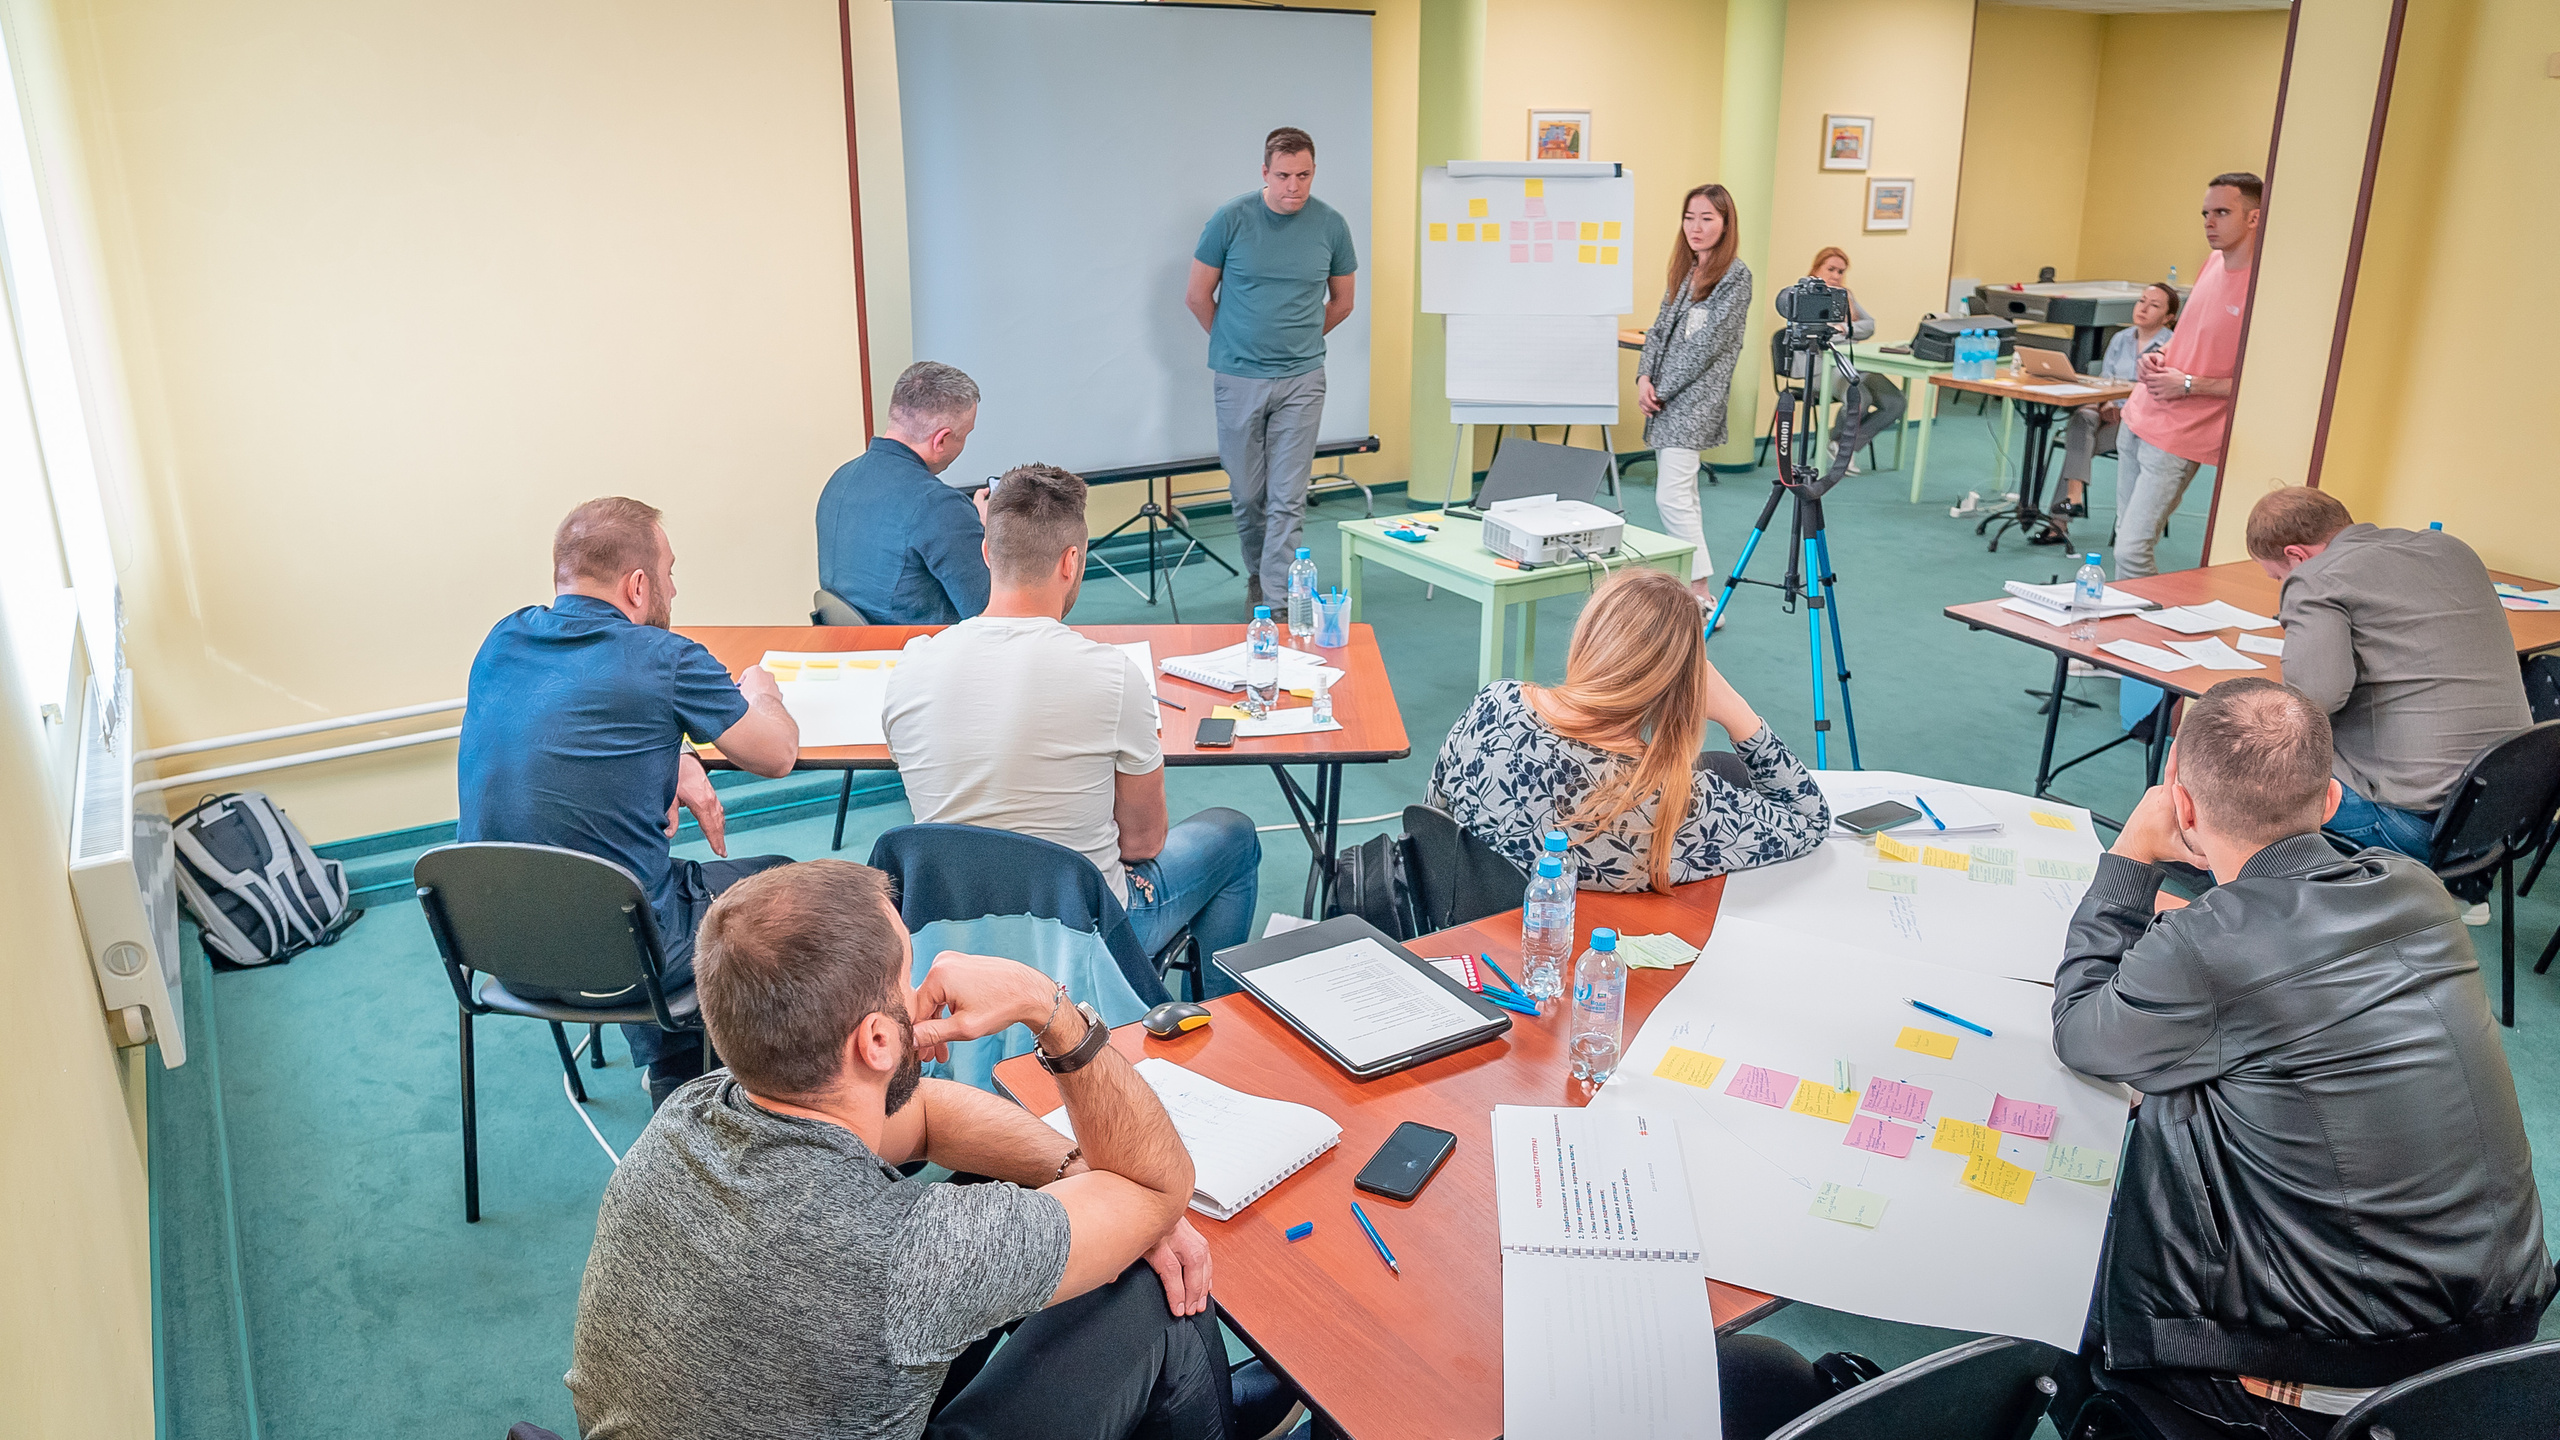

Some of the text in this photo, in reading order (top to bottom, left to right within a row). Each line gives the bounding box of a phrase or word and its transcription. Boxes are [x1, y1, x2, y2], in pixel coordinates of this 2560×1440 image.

[1780, 421, 1790, 456] Canon
[1531, 1137, 1540, 1165] СТРУКТУРА?
[1556, 1148, 1566, 1187] вспомогательные
[1571, 1161, 1579, 1185] вертикаль
[1533, 1165, 1542, 1198] ПОКАЗЫВАЕТ
[1573, 1189, 1583, 1216] управления
[1624, 1186, 1634, 1210] результат
[1561, 1192, 1571, 1233] Зарабатывающие
[1629, 1214, 1638, 1235] Функции
[1603, 1219, 1611, 1234] Линии
